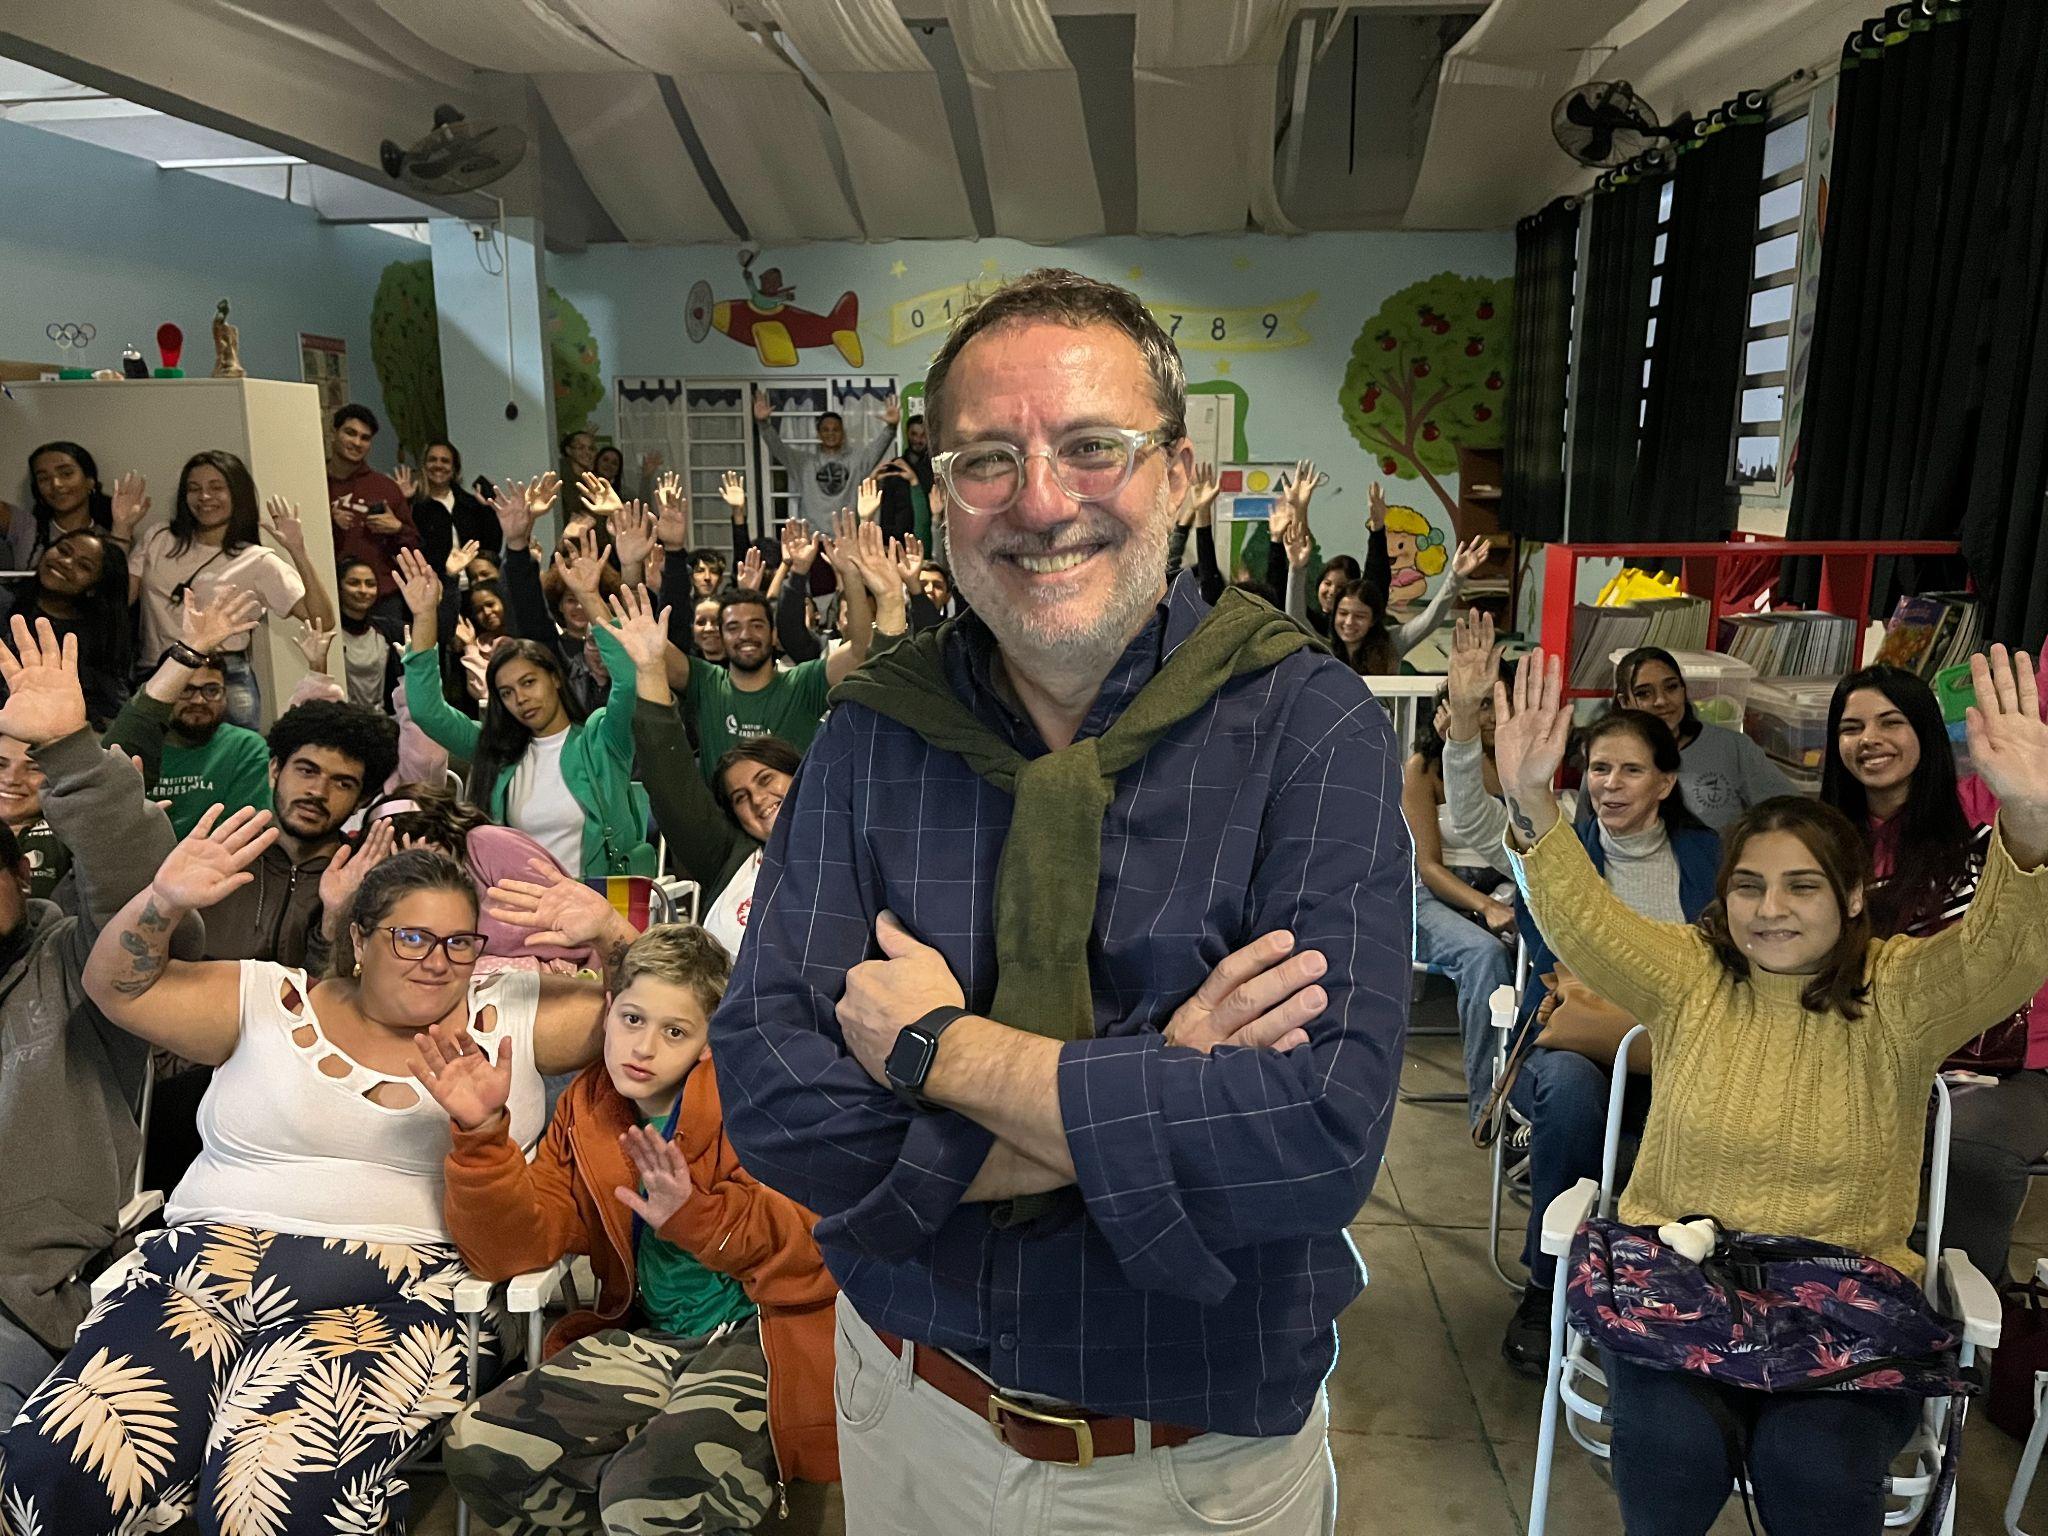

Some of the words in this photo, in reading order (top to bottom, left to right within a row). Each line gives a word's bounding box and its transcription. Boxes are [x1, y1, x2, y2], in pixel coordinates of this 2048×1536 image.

[911, 309, 924, 328] 0
[943, 299, 951, 320] 1
[1169, 314, 1182, 337] 7
[1211, 317, 1225, 340] 8
[1262, 313, 1278, 339] 9
